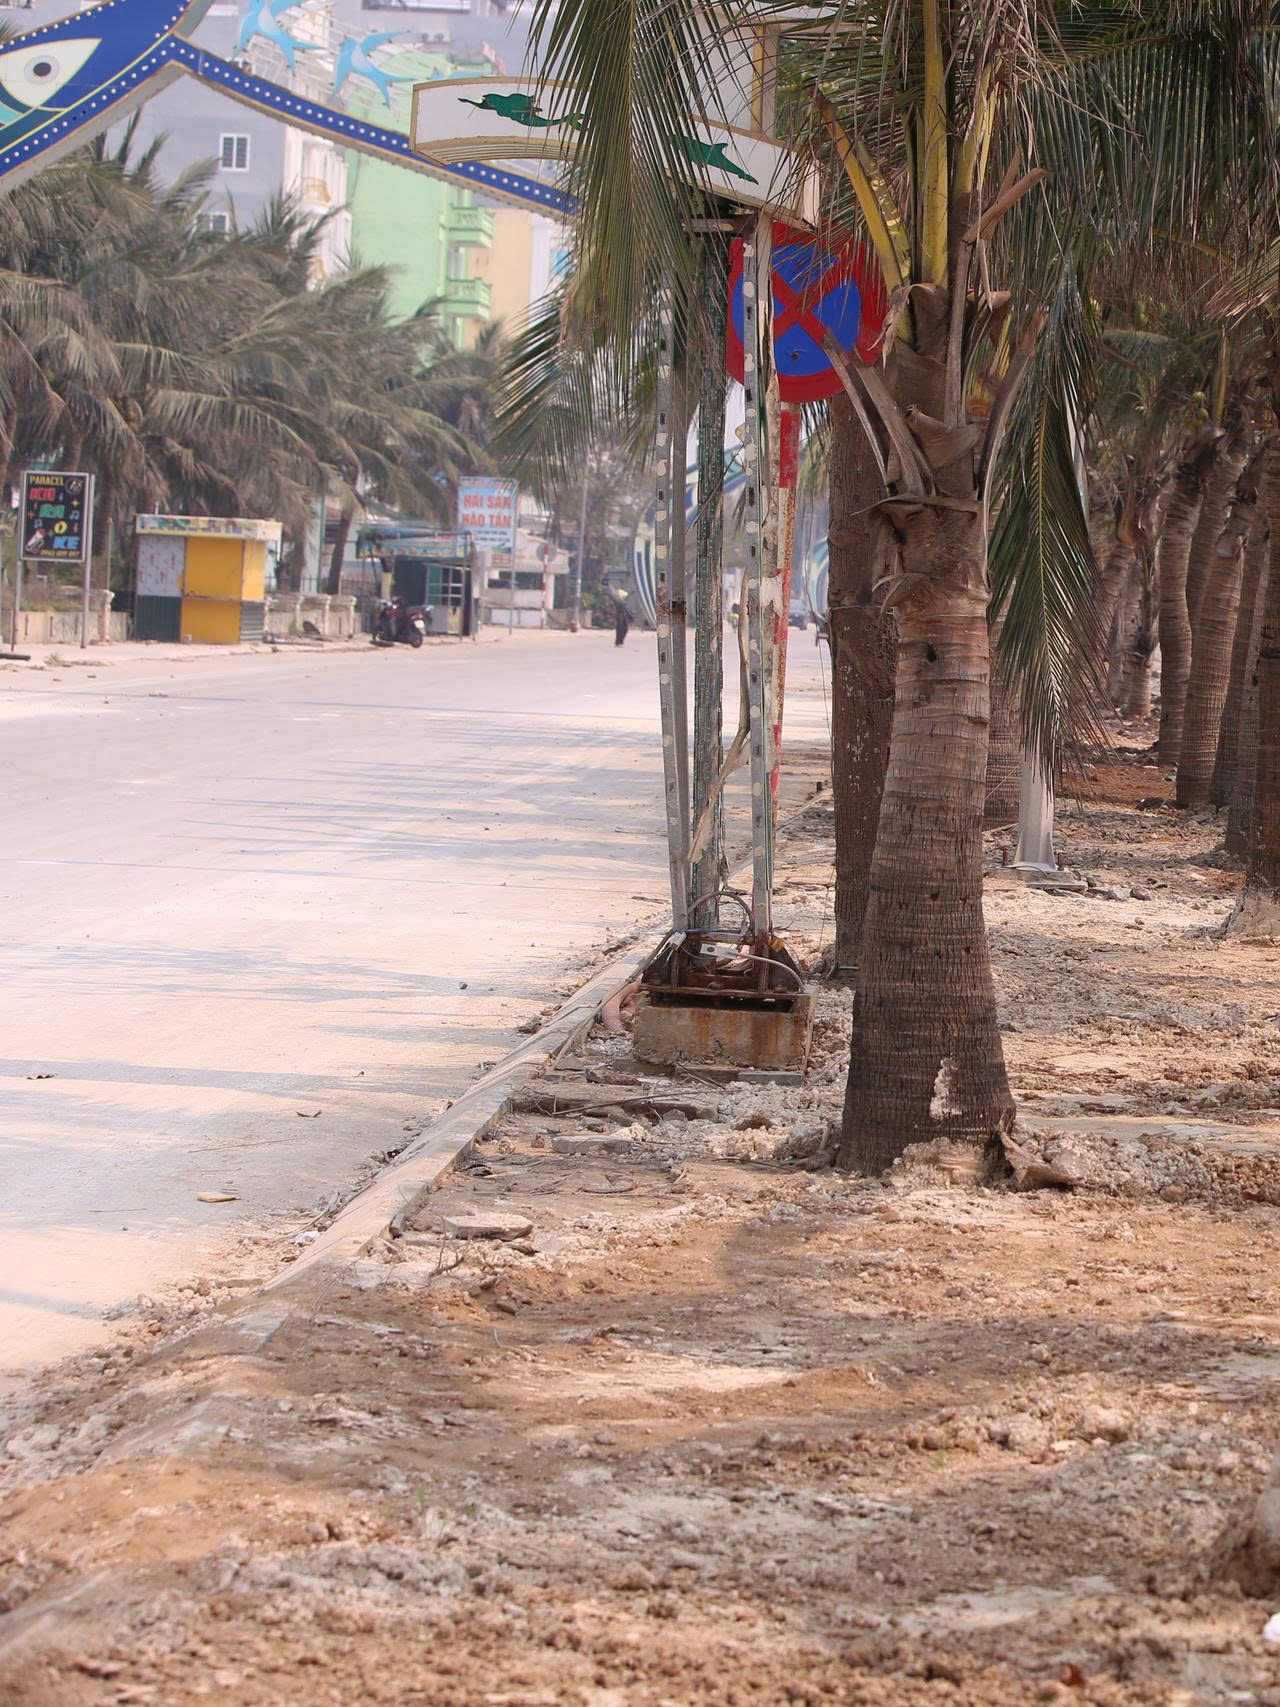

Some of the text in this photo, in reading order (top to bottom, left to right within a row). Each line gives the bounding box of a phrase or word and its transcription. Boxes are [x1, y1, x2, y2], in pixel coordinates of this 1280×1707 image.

[30, 475, 64, 486] PARACEL
[54, 521, 68, 534] O
[53, 535, 80, 549] KE
